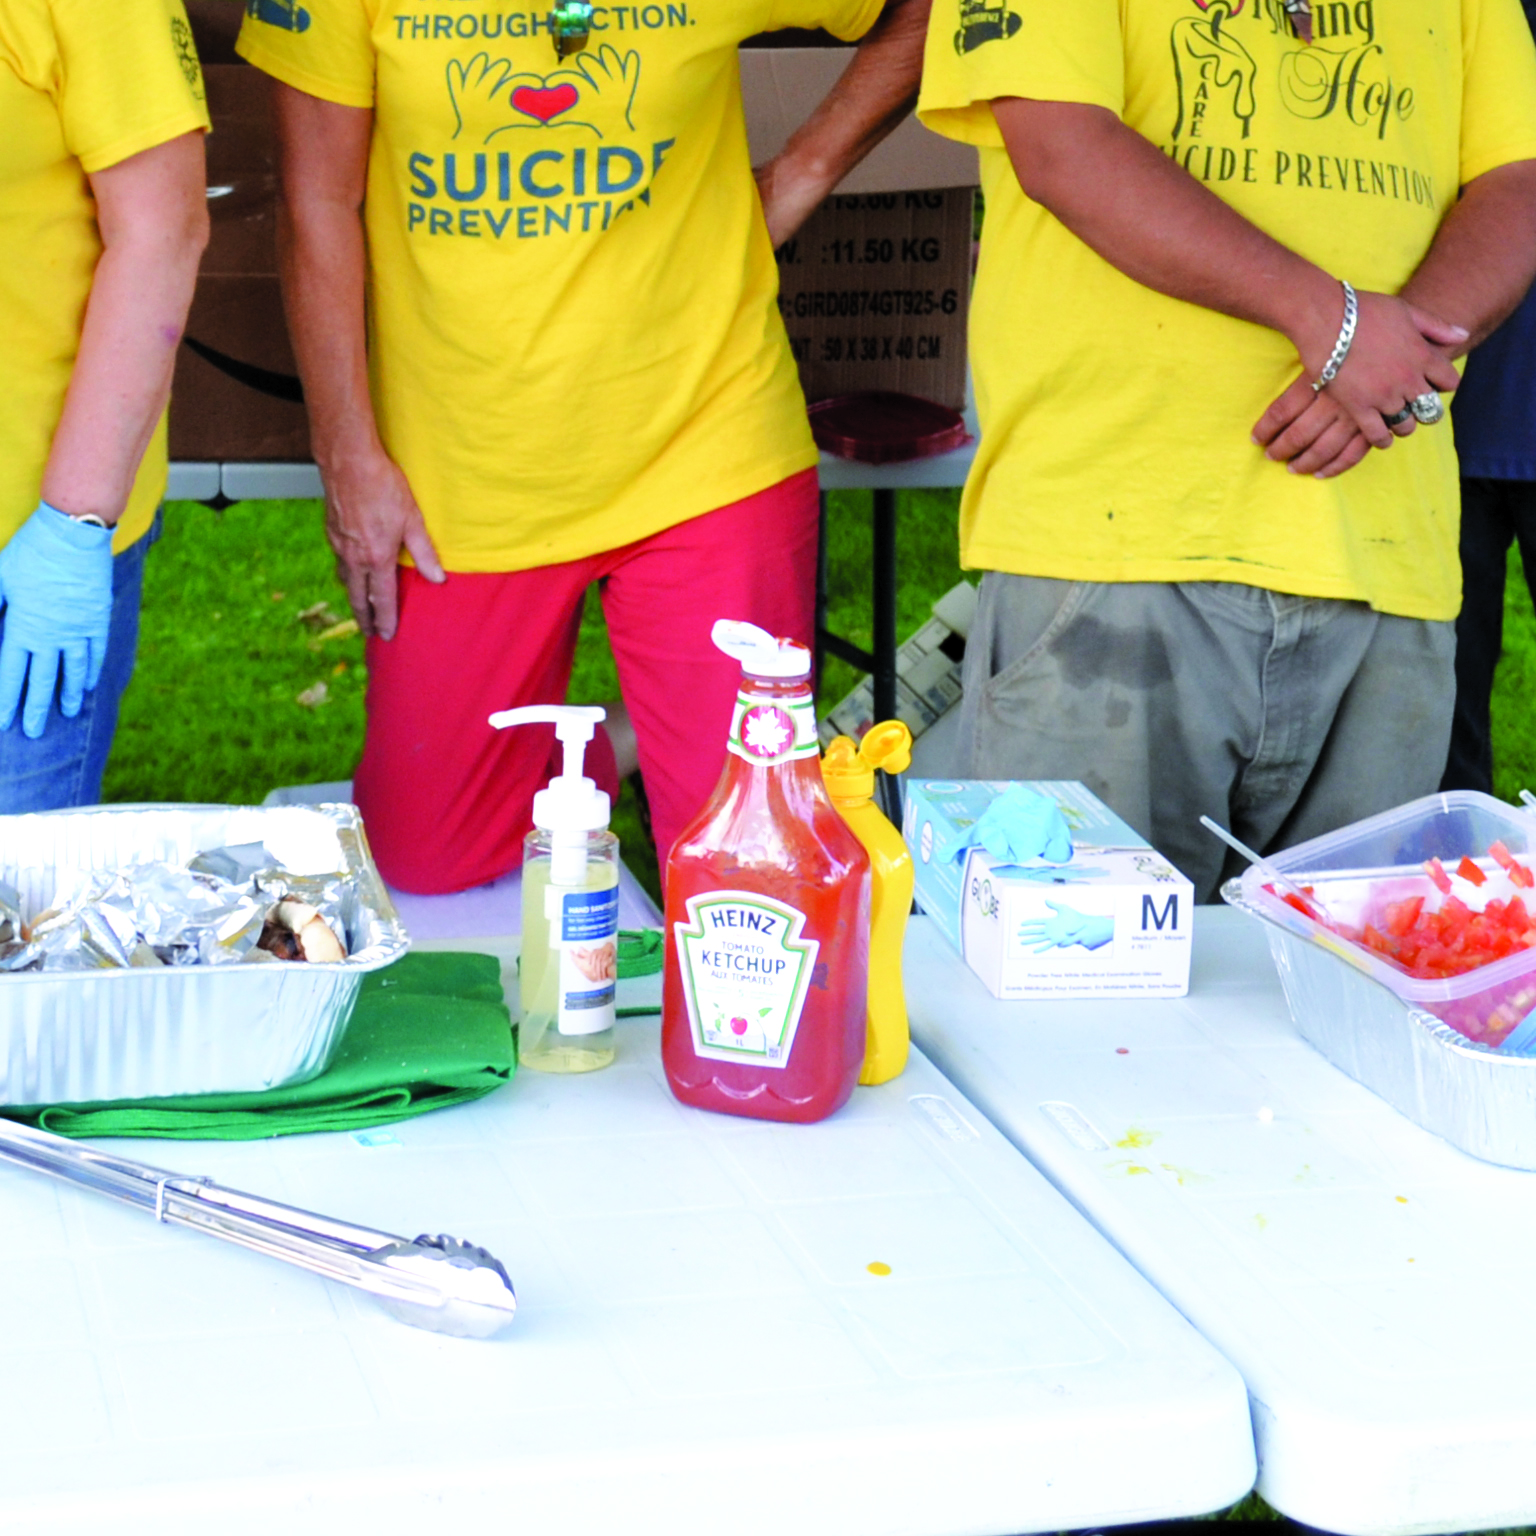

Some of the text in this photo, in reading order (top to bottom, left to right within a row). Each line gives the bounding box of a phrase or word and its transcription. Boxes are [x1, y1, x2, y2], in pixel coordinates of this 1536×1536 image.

[590, 2, 696, 31] CTION.
[1190, 61, 1212, 138] CARE
[1274, 150, 1435, 210] PREVENTION
[408, 187, 651, 240] PREVENTI
[902, 238, 939, 262] KG
[710, 909, 776, 936] HEINZ
[1141, 894, 1178, 930] M
[701, 949, 786, 975] KETCHUP
[722, 941, 764, 955] TOMATO
[732, 972, 774, 986] TOMATES
